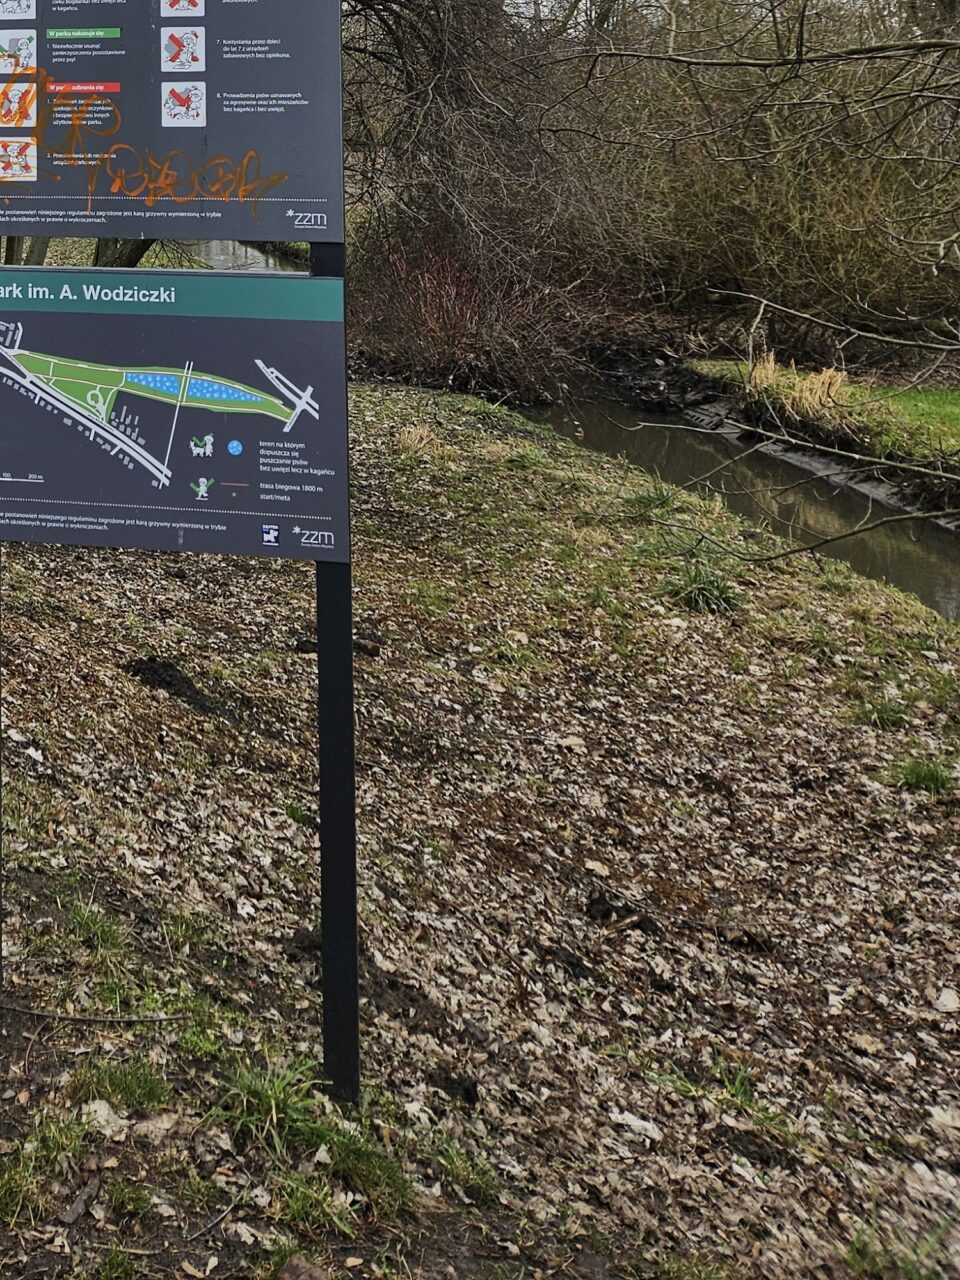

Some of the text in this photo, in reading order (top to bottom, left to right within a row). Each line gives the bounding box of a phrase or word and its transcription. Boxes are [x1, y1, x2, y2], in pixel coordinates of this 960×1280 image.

[29, 284, 54, 299] im.
[60, 285, 77, 300] A.
[83, 285, 175, 302] Wodziczki
